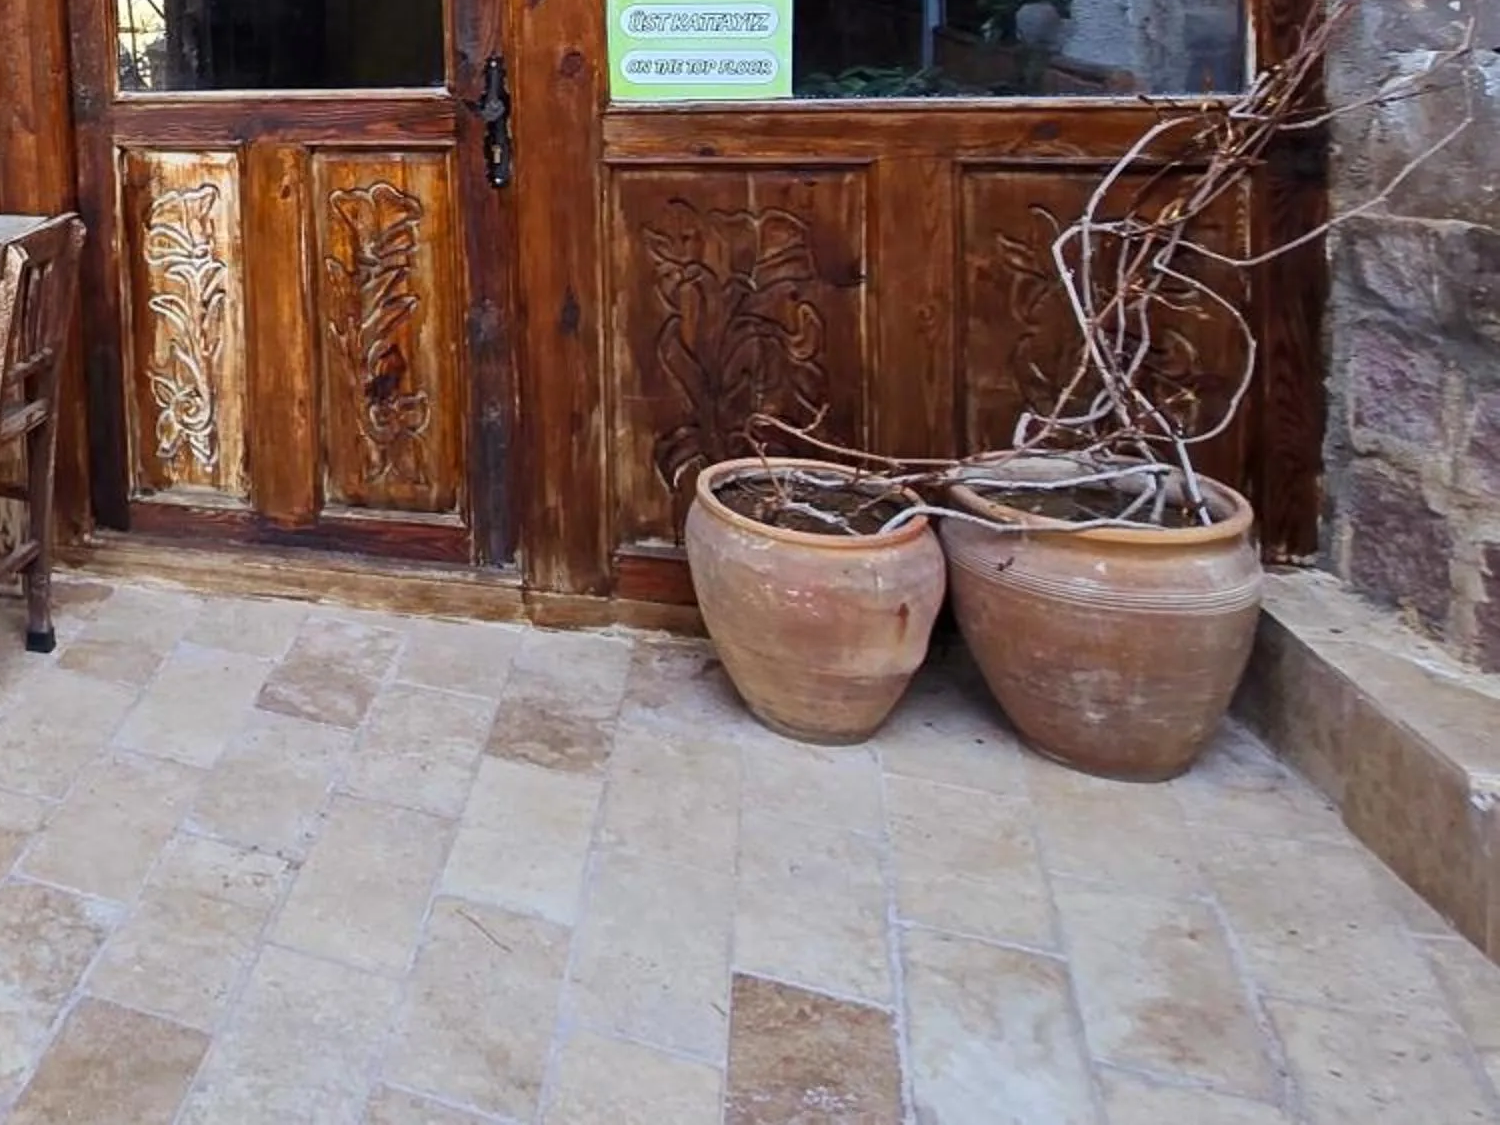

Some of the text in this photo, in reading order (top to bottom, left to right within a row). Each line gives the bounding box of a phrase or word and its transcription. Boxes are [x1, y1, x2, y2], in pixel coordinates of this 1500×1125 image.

[628, 9, 771, 32] ÜST KATTAYIZ
[626, 58, 773, 75] ON THE TOP FLOOR
